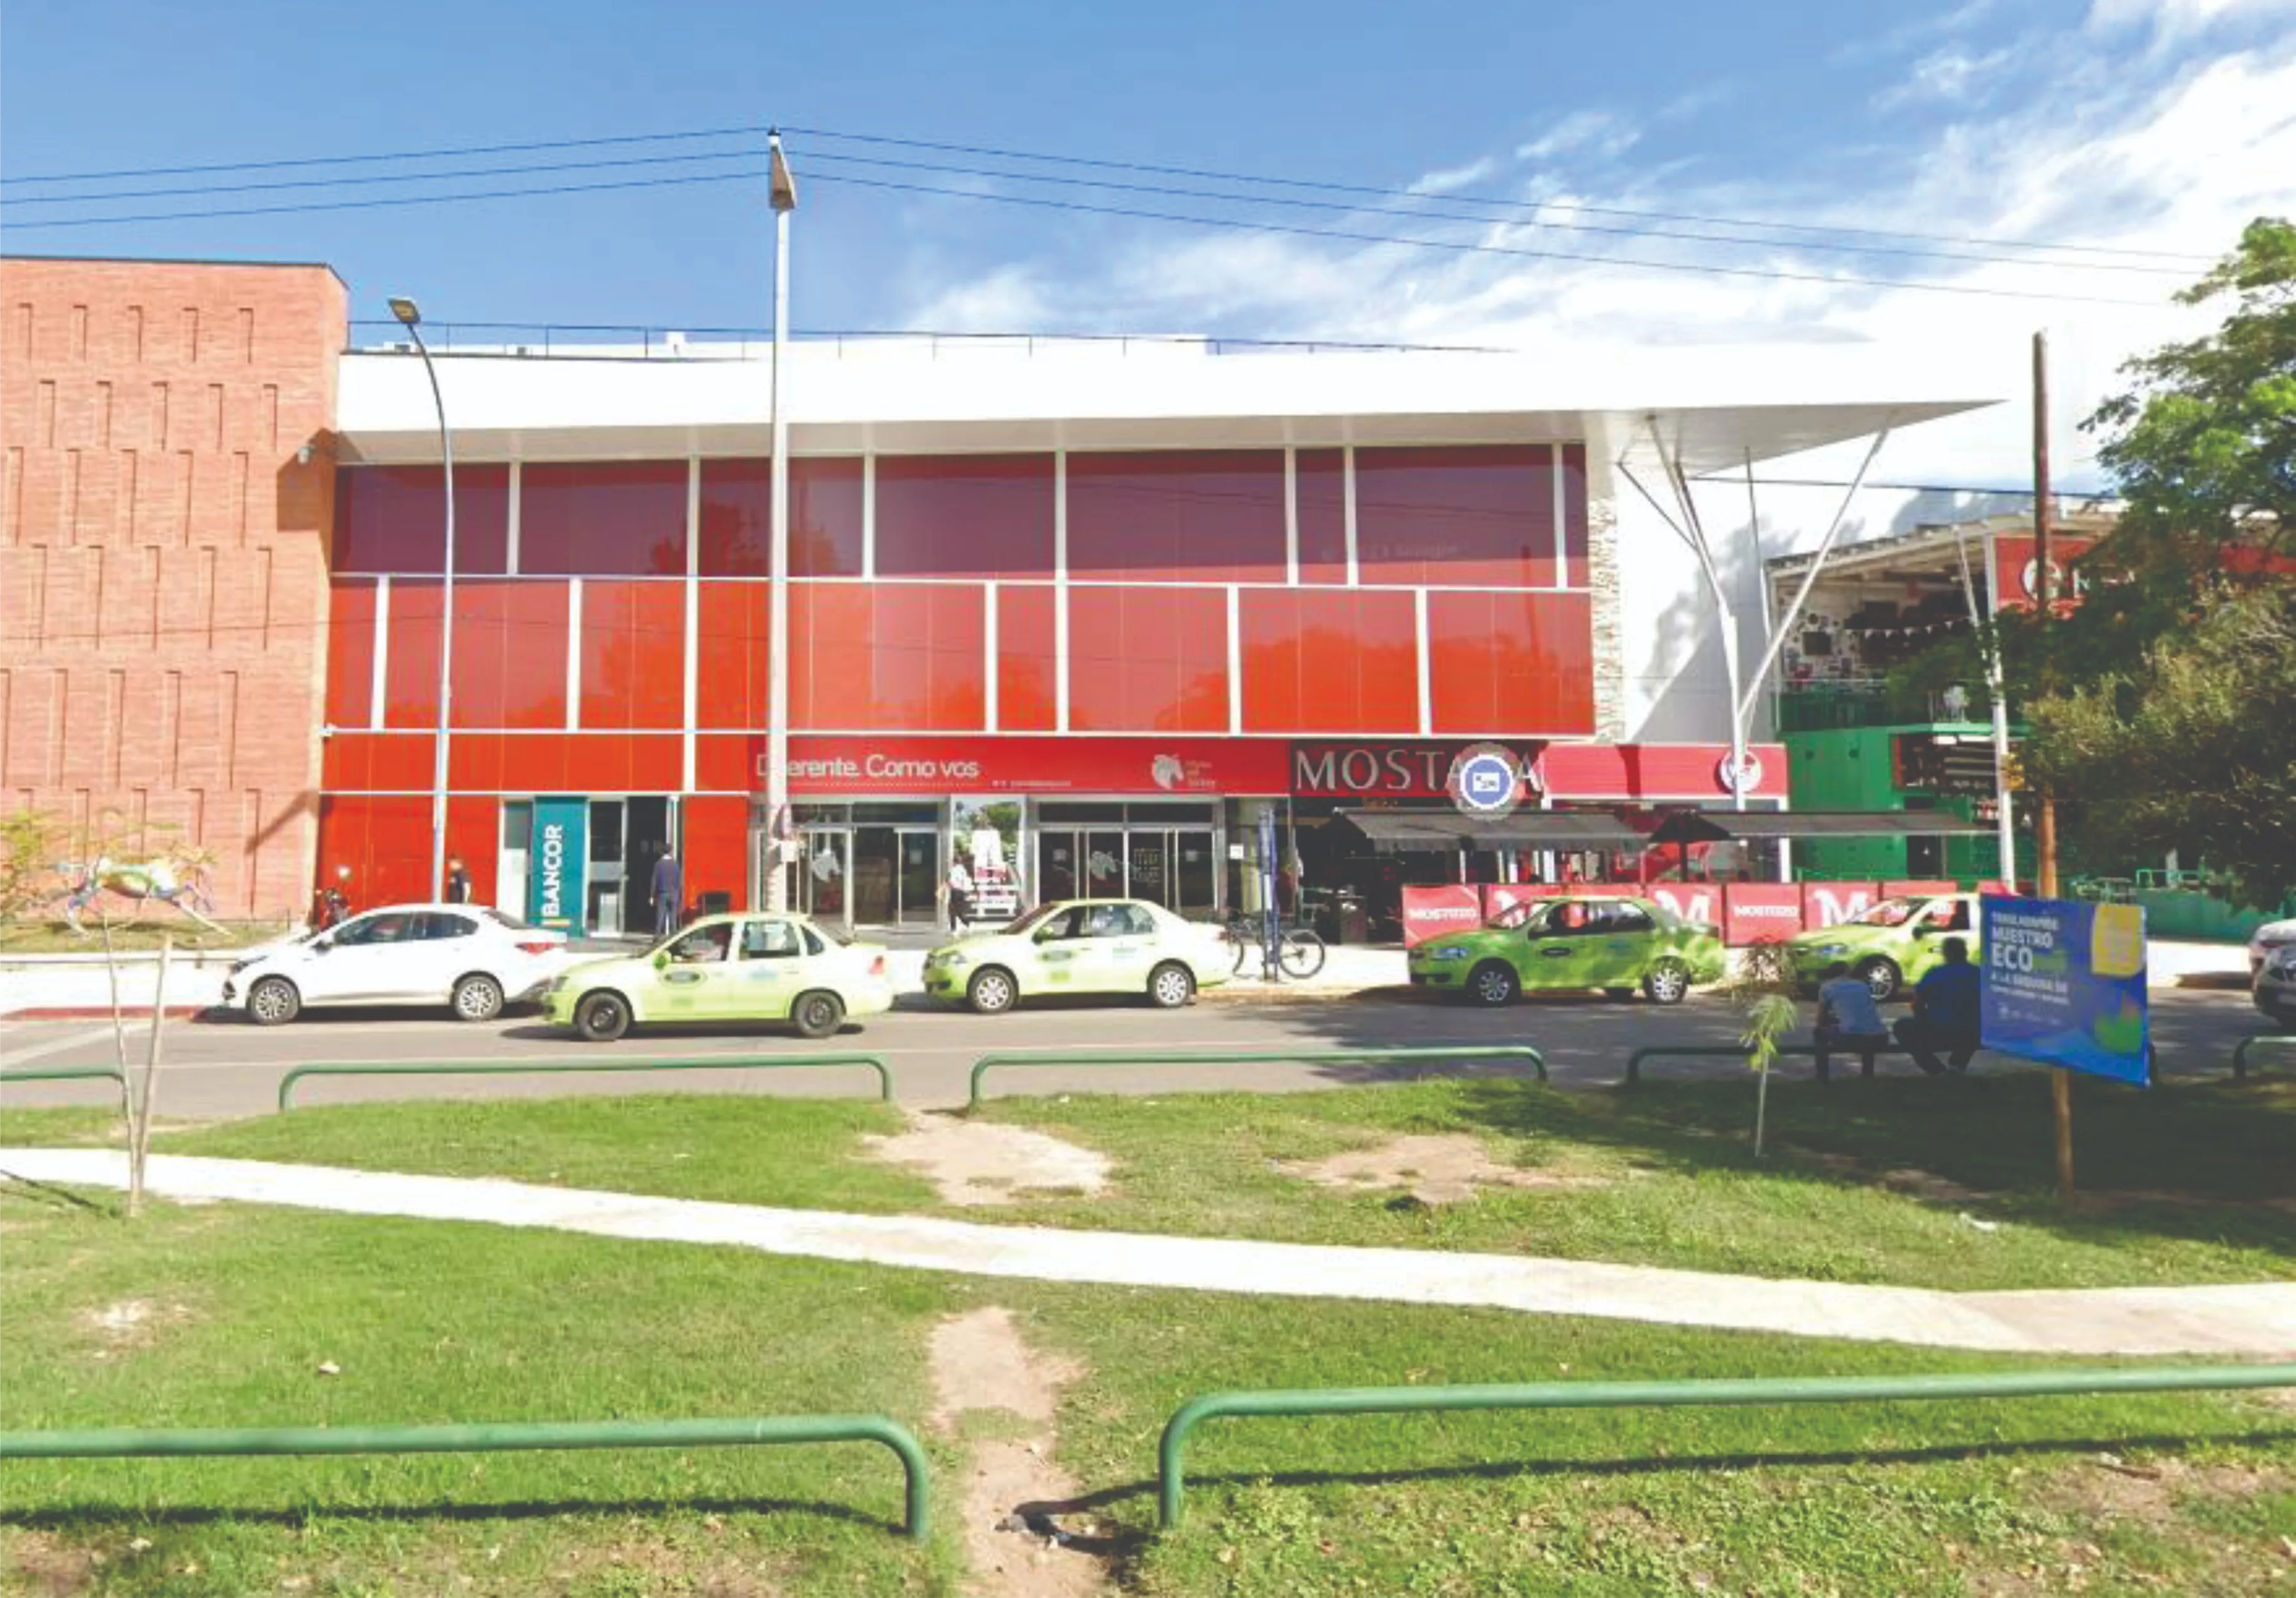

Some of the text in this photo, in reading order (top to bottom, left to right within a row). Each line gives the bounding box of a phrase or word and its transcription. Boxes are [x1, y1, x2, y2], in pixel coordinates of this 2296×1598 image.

[757, 754, 980, 778] Derente. Como vos
[1296, 749, 1542, 791] MOSTA
[542, 824, 562, 917] BANCOR
[1813, 889, 1867, 928] M
[1991, 943, 2033, 972] ECO
